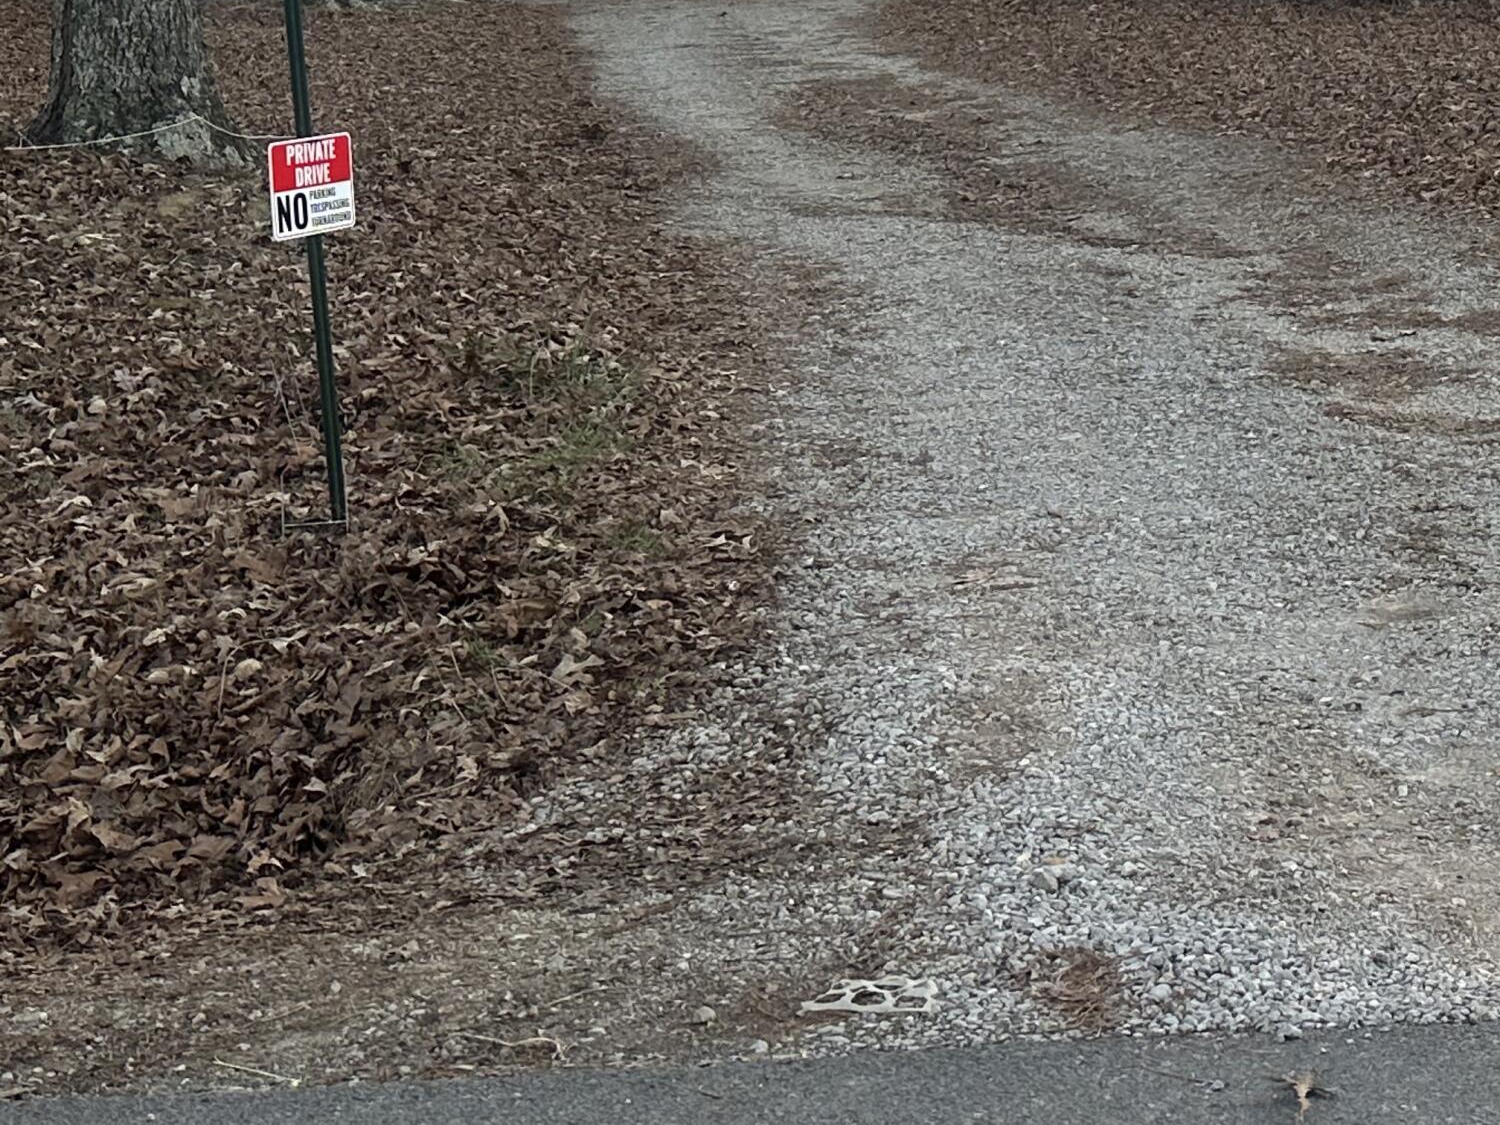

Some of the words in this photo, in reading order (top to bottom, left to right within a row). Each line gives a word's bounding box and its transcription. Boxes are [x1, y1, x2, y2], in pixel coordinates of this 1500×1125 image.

[286, 138, 336, 166] PRIVATE
[295, 162, 331, 188] DRIVE
[309, 187, 336, 200] PARKING
[276, 192, 308, 233] NO
